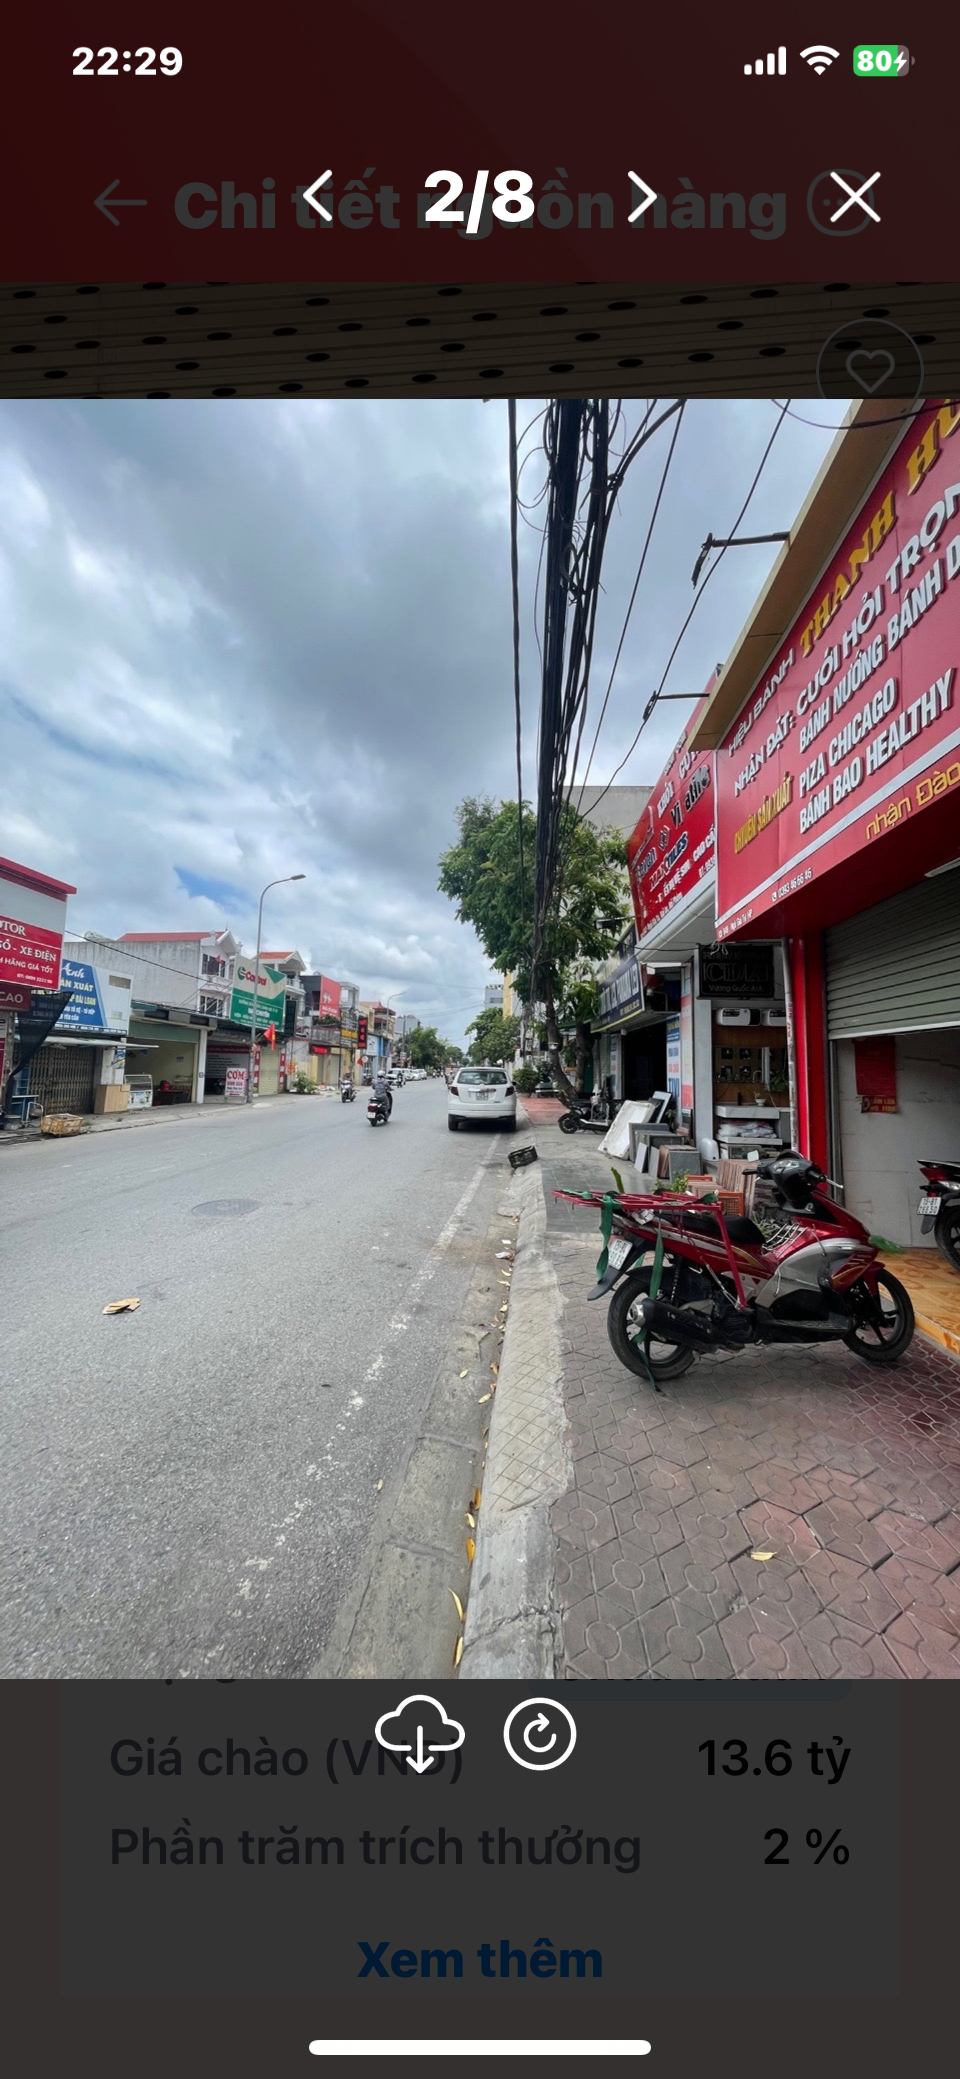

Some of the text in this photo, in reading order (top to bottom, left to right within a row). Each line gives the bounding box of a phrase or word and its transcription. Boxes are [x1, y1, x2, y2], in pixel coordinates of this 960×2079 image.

[752, 647, 796, 720] BÁNH
[800, 489, 898, 659] THANH
[734, 745, 767, 797] NHẬN
[796, 643, 842, 717] CƯỚI
[842, 584, 886, 659] HỎI
[799, 696, 833, 754] BÁNH
[832, 633, 886, 715] NƯỚNG
[886, 558, 946, 652] BÁNH
[799, 677, 898, 799] PIZA CHICAGO
[799, 667, 955, 834] BÁNH BAO HEALTHY
[866, 795, 913, 840] nhận
[4, 957, 27, 969] HÃNG
[27, 962, 40, 971] GIÁ
[19, 945, 35, 957] XE
[34, 948, 57, 963] ĐIỆN
[245, 970, 267, 986] Catrol
[709, 984, 732, 993] Vương
[732, 983, 751, 992] Quốc
